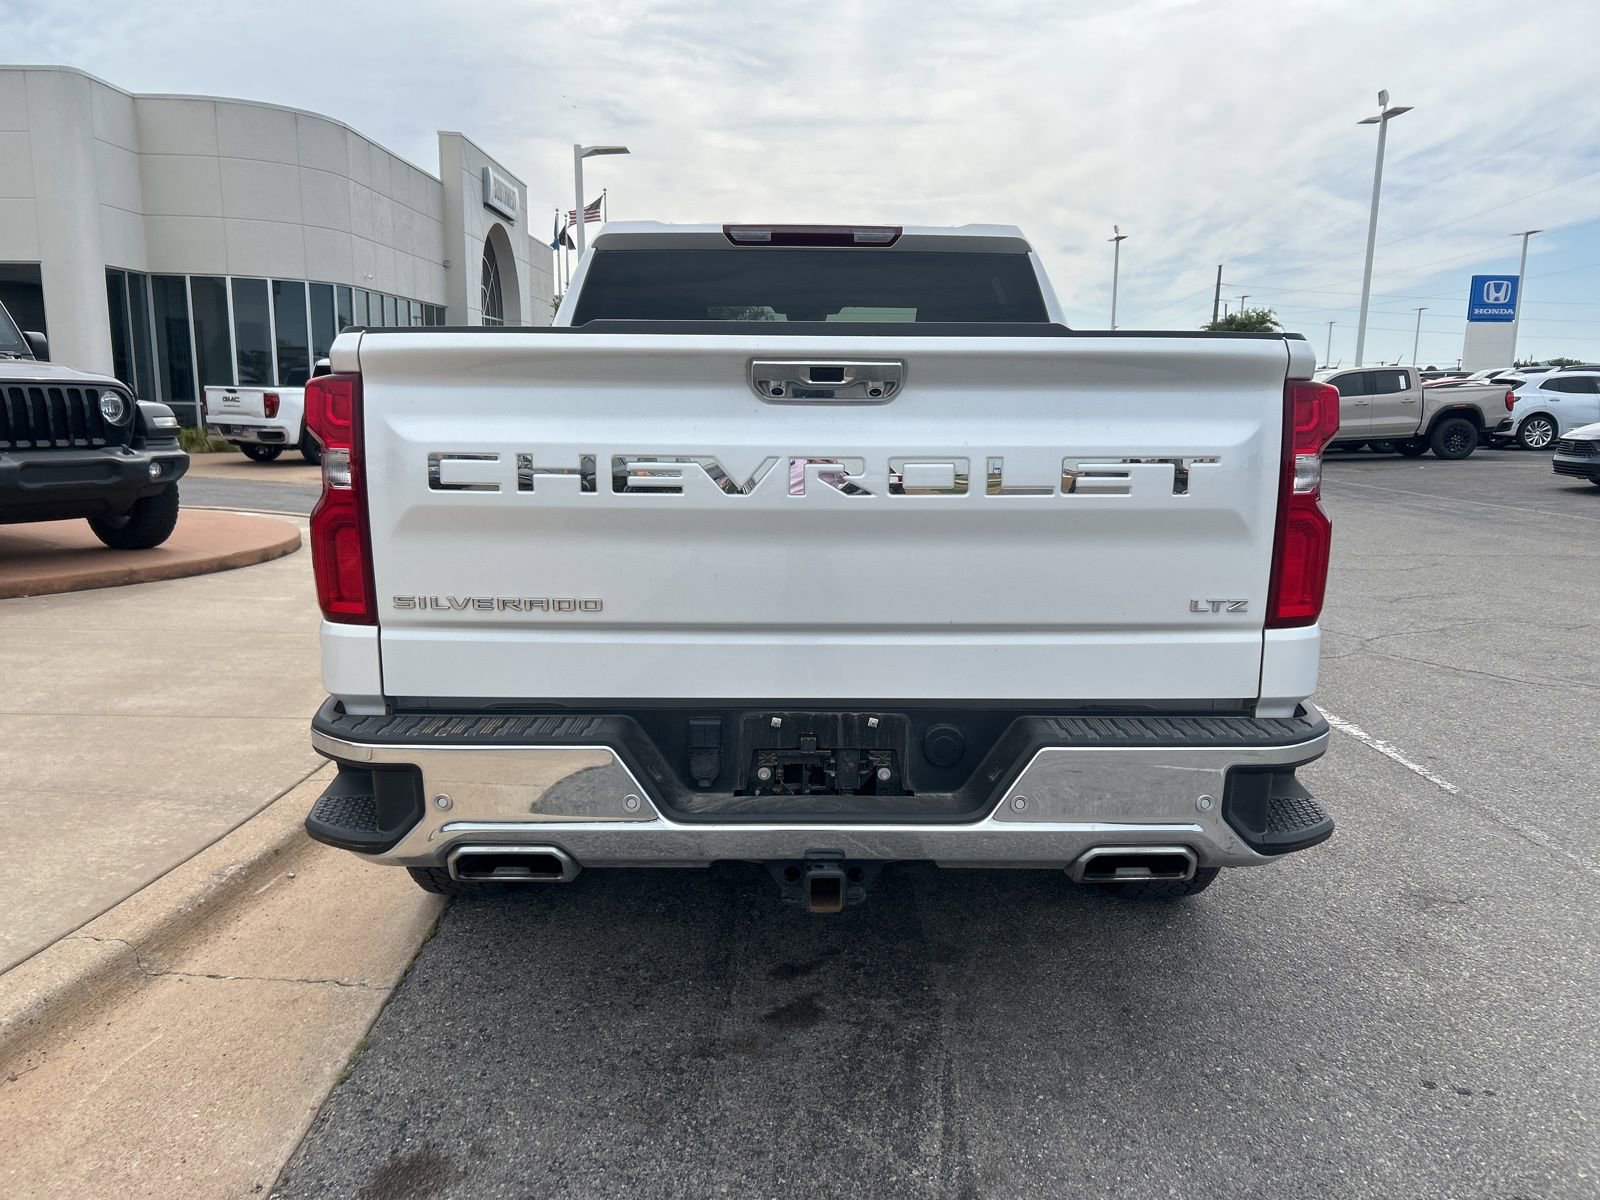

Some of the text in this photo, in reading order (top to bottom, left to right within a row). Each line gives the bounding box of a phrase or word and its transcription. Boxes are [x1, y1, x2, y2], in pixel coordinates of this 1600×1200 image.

[427, 452, 1222, 497] CHEVROLET
[392, 595, 604, 612] SILVERADO
[1189, 599, 1249, 613] LTZ
